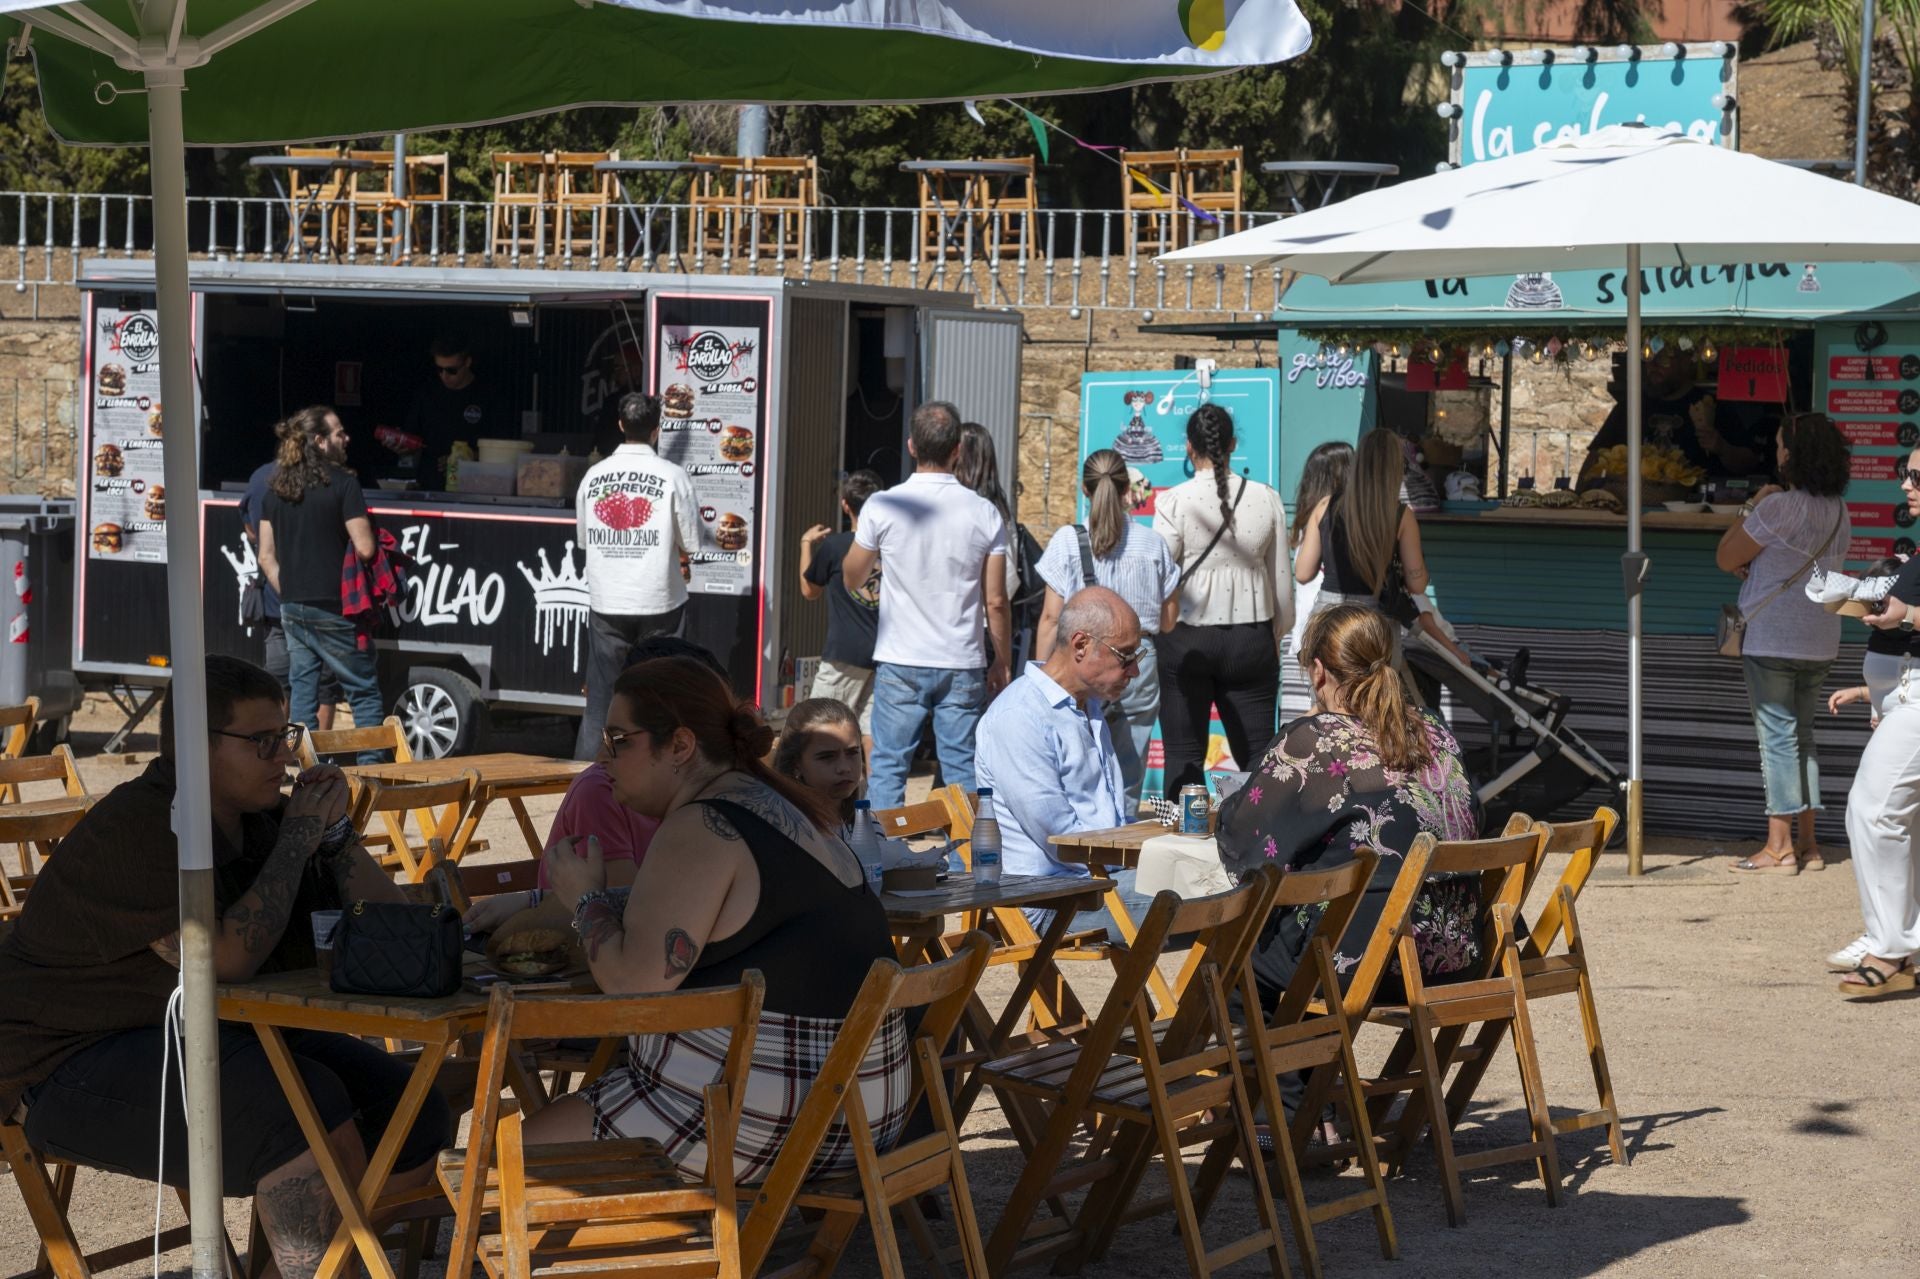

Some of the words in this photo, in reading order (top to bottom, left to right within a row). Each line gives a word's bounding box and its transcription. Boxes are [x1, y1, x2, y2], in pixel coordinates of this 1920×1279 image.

[1471, 89, 1513, 160] la
[134, 321, 143, 332] EL
[704, 339, 713, 350] EL
[688, 349, 733, 366] ENROLLAO
[1726, 357, 1781, 373] Pedidos
[707, 384, 717, 392] LA
[718, 384, 742, 392] DIOSA
[662, 421, 672, 429] LA
[673, 421, 706, 430] LLORONA
[686, 464, 696, 472] LA
[697, 464, 739, 474] ENROLLADA
[589, 471, 626, 488] ONLY
[628, 472, 667, 488] DUST
[587, 487, 600, 499] IS
[602, 482, 665, 499] FOREVER
[401, 523, 432, 565] EL
[588, 528, 606, 545] TOO
[607, 528, 632, 546] LOUD
[632, 529, 660, 547] 2FADE
[692, 552, 702, 560] LA
[704, 552, 735, 561] CLASICA
[388, 562, 506, 628] OLLAO
